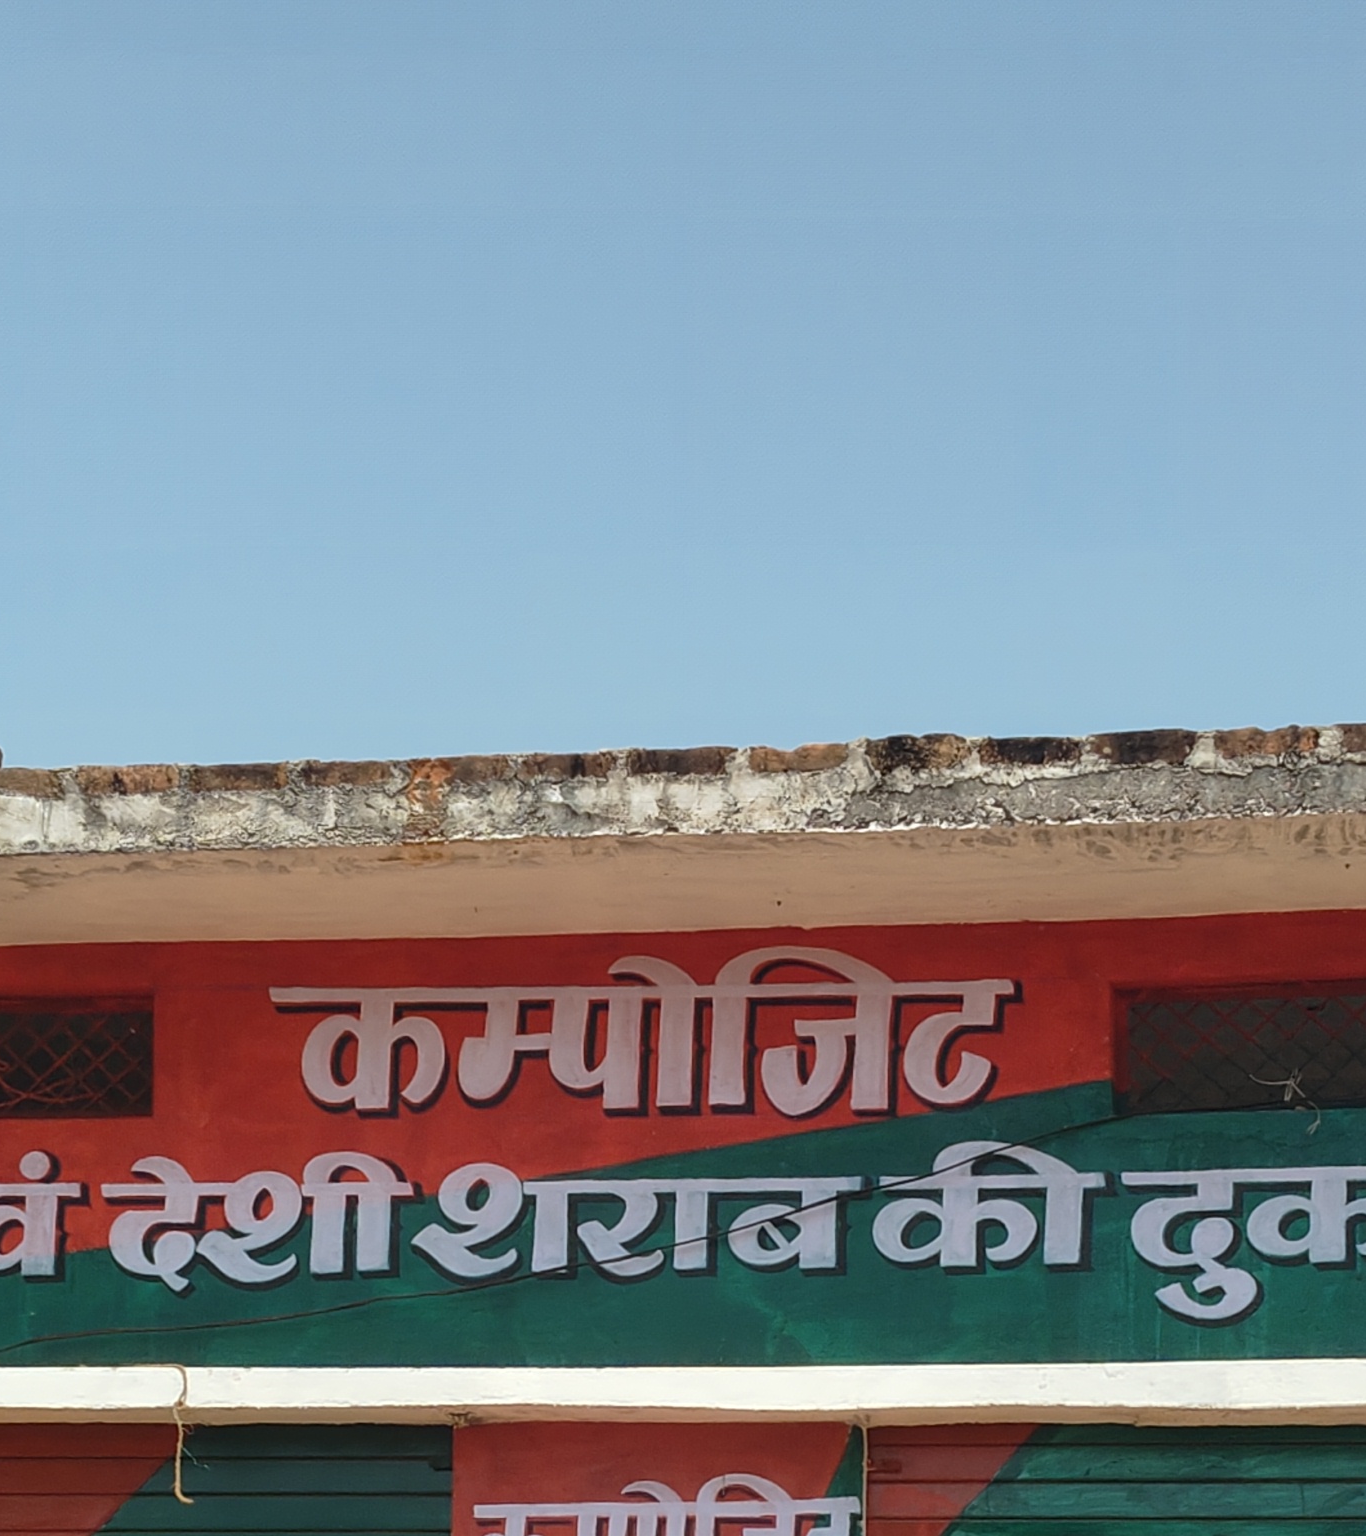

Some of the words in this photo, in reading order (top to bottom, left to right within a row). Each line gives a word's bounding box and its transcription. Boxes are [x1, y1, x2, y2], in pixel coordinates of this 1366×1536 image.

[269, 946, 1015, 1117] कम्पोजिट
[101, 1151, 414, 1293] देशी
[411, 1162, 863, 1279] शराब
[871, 1140, 1106, 1268] की
